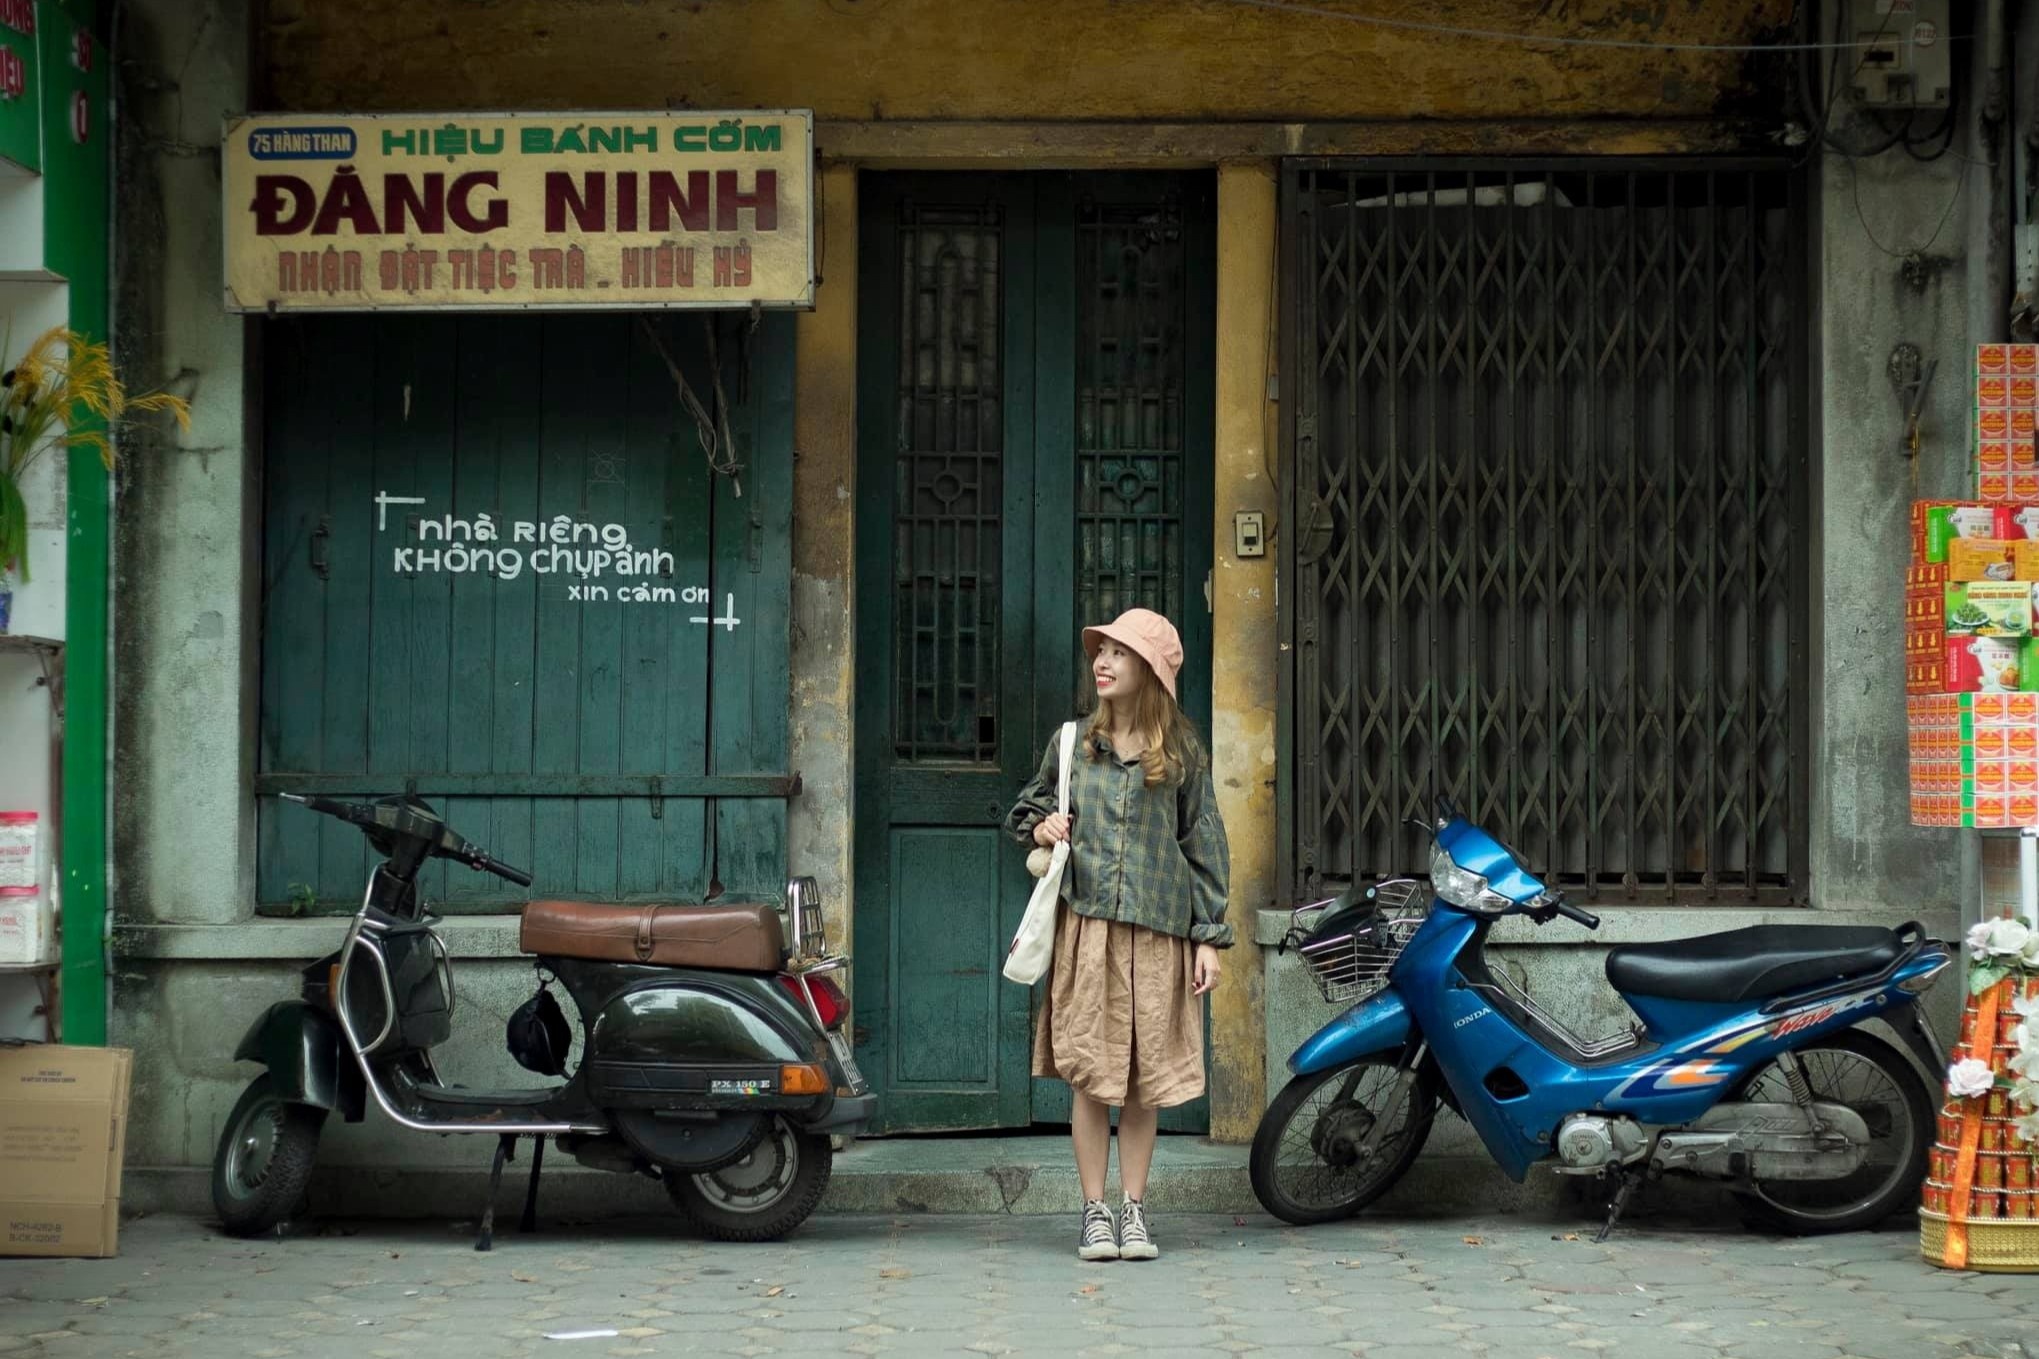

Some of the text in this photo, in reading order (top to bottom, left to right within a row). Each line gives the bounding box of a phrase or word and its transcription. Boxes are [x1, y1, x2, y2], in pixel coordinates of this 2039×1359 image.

[253, 130, 352, 152] 75 HÀNG THAN
[382, 118, 782, 163] HIỆU BÁNH CỐM
[249, 165, 777, 236] ĐĂNG NINH
[278, 243, 362, 296] NHẬN
[379, 242, 438, 296] ĐẶT
[448, 242, 517, 295] TIỆC
[419, 512, 498, 542] nhà
[614, 544, 675, 576] ảnh
[567, 584, 609, 601] xin
[616, 582, 676, 602] cảm
[1453, 1007, 1491, 1029] ONDA
[711, 1080, 732, 1088] PX
[735, 1080, 758, 1088] 150
